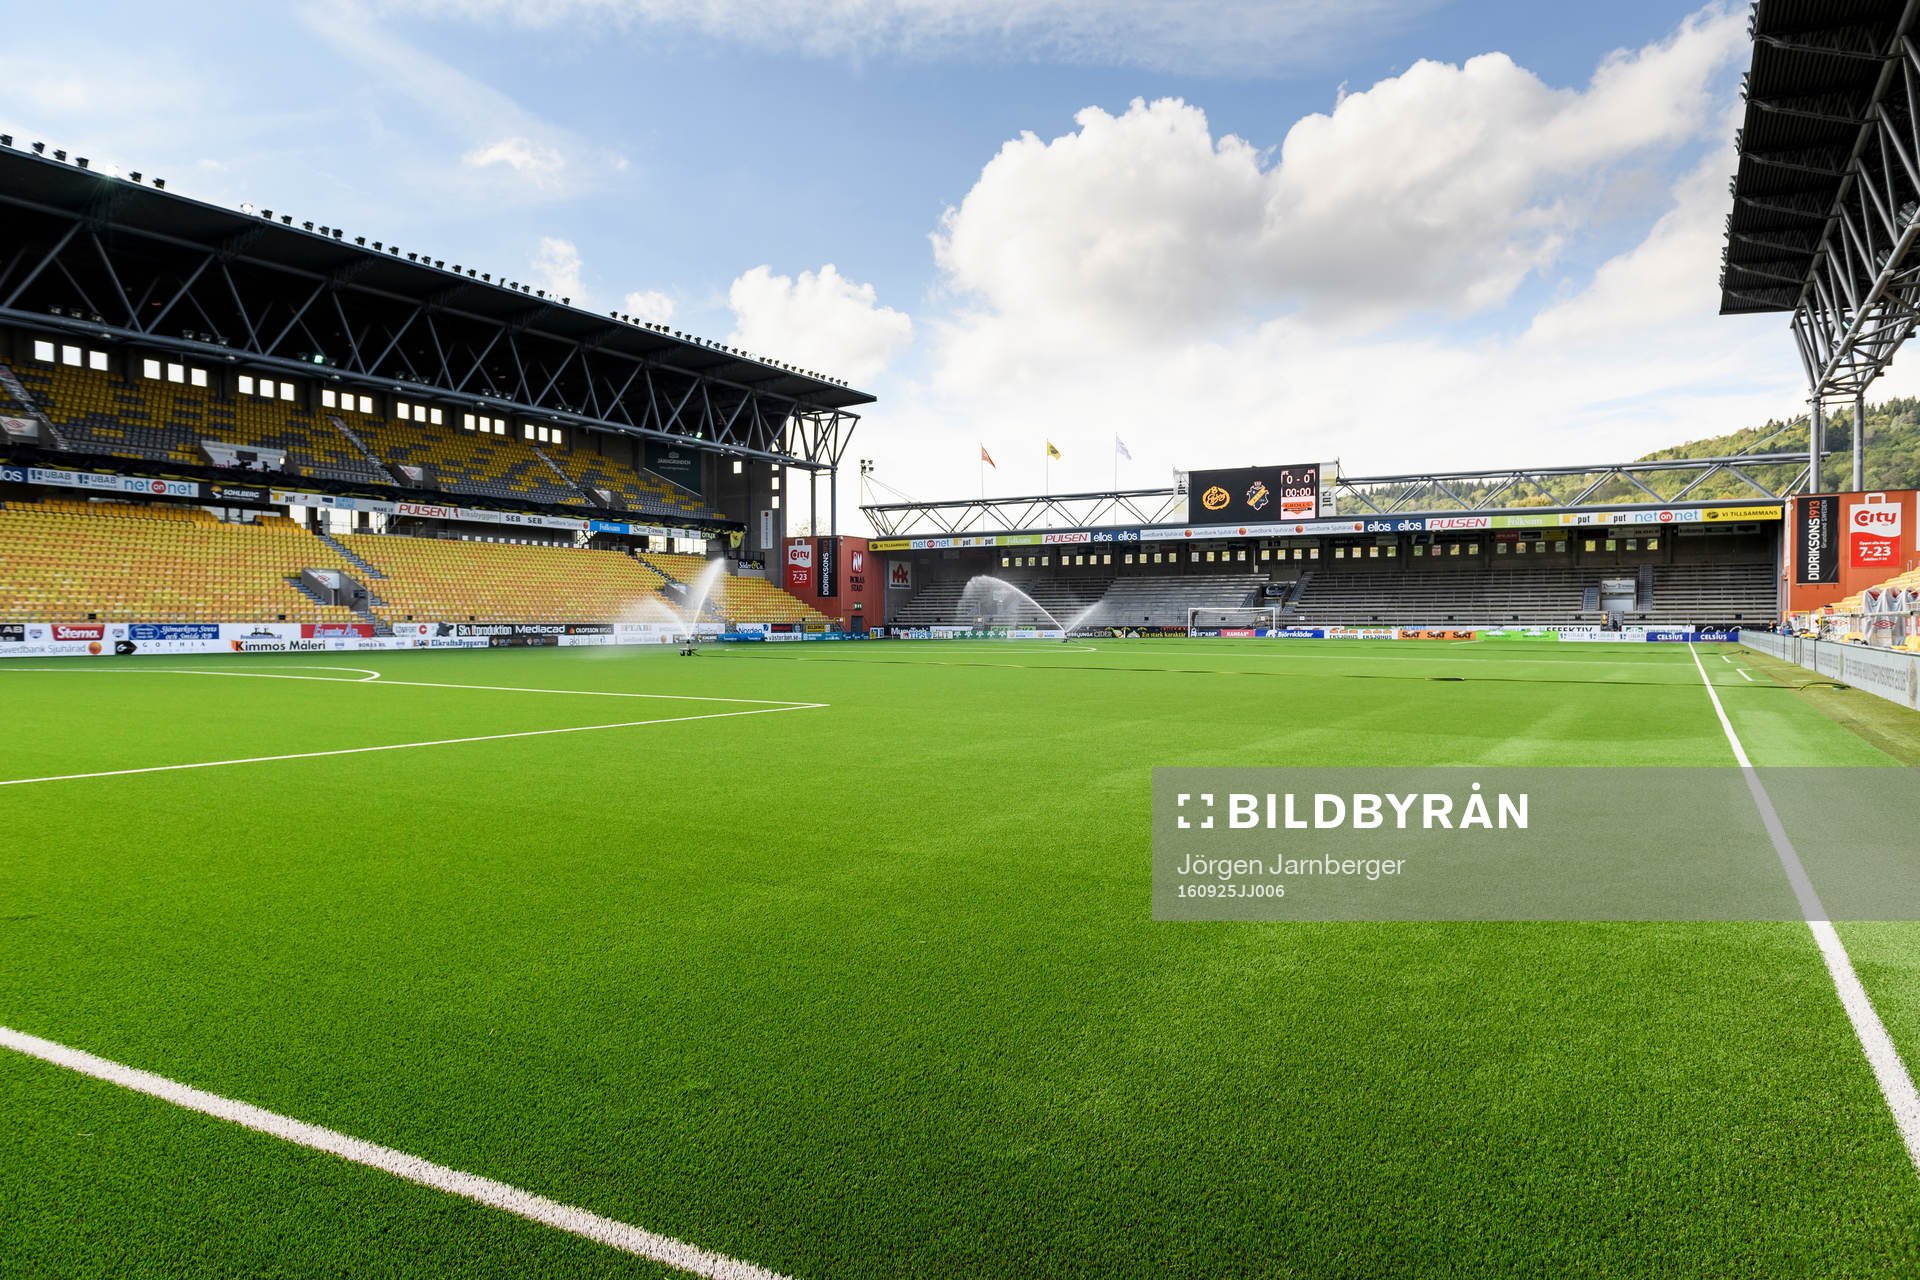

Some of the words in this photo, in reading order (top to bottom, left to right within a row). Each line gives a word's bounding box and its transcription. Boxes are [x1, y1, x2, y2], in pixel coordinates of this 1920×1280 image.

[44, 471, 72, 480] UBAB
[1286, 474, 1293, 485] 0
[1303, 473, 1310, 484] 0
[1285, 487, 1311, 497] 00:00
[399, 504, 447, 518] PULSEN
[505, 514, 521, 523] SEB
[527, 516, 543, 525] SEB
[1577, 515, 1590, 524] put
[1613, 514, 1626, 522] put
[1854, 510, 1897, 527] City
[1368, 521, 1391, 532] ellos
[1398, 520, 1422, 531] ellos
[1429, 518, 1488, 529] PULSEN
[1045, 534, 1088, 543] PULSEN
[1093, 532, 1113, 542] ellos
[1118, 531, 1138, 540] ellos
[791, 549, 809, 560] City
[1859, 546, 1891, 557] 7-23
[792, 573, 808, 581] 7-23
[515, 625, 565, 634] Mediacad
[235, 641, 286, 652] Kimmos
[289, 640, 326, 651] Måleri
